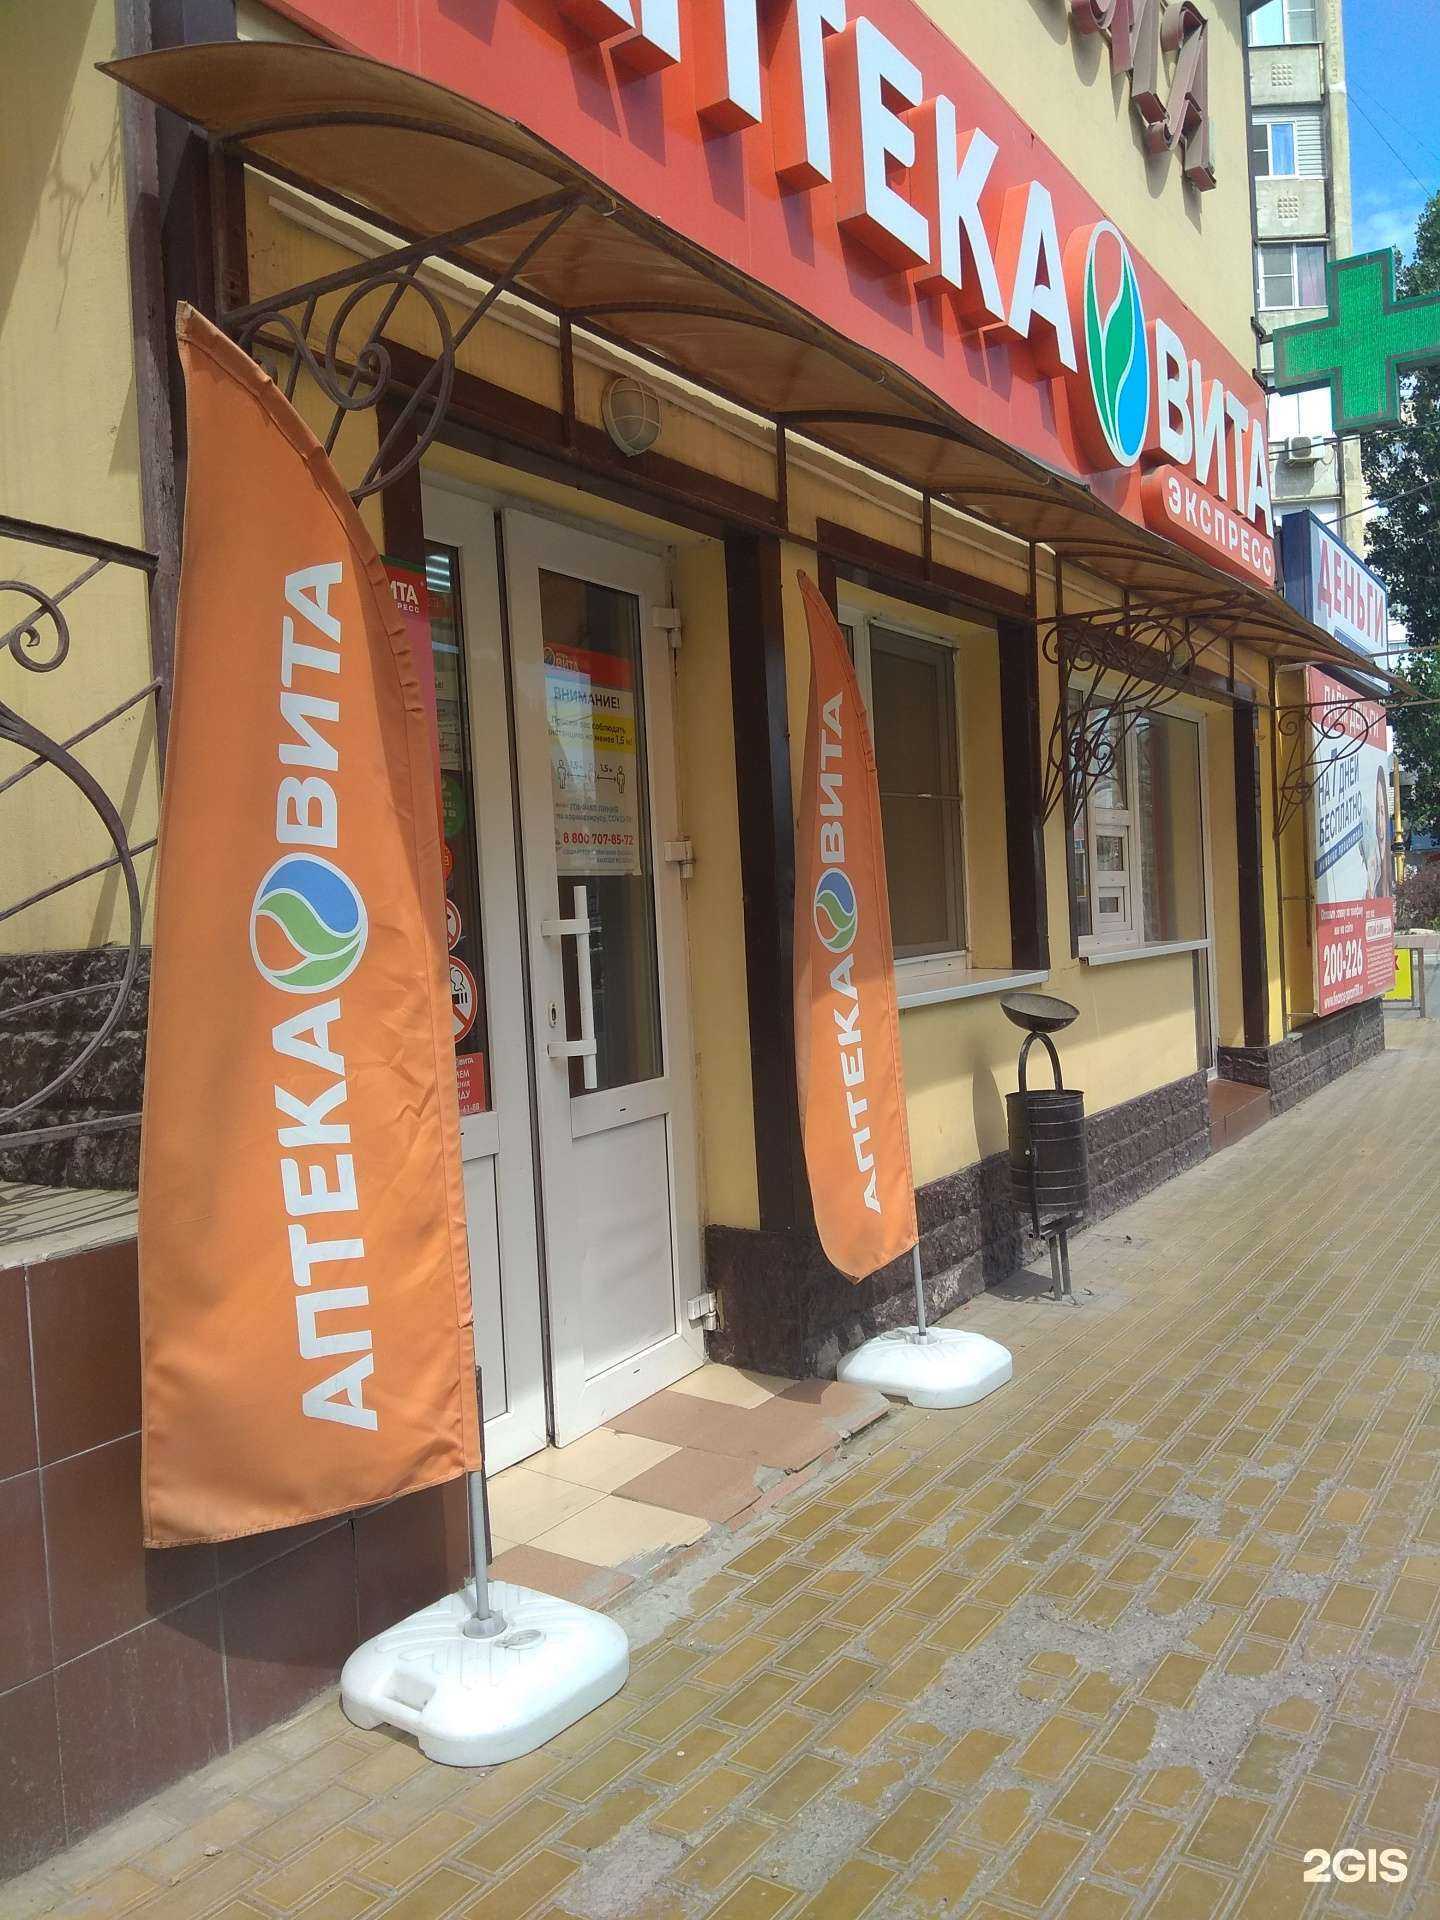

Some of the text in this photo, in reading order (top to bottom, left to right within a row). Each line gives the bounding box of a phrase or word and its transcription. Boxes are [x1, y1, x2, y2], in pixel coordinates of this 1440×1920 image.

[604, 0, 1078, 374] ТЕКА
[1155, 317, 1275, 539] ВИТА
[1167, 476, 1275, 578] ЭКСПРЕСС
[390, 580, 419, 606] ТА
[1317, 539, 1384, 648] ДЕНЬГИ
[552, 686, 621, 710] ВНИМАНИЕ!
[563, 832, 570, 844] 8
[1319, 789, 1363, 848] БЕСПЛАТНО
[819, 691, 882, 1215] АПТЕКА ВИТА
[1323, 937, 1363, 987] 200-226
[272, 561, 379, 1431] АПТЕКА ВИТА
